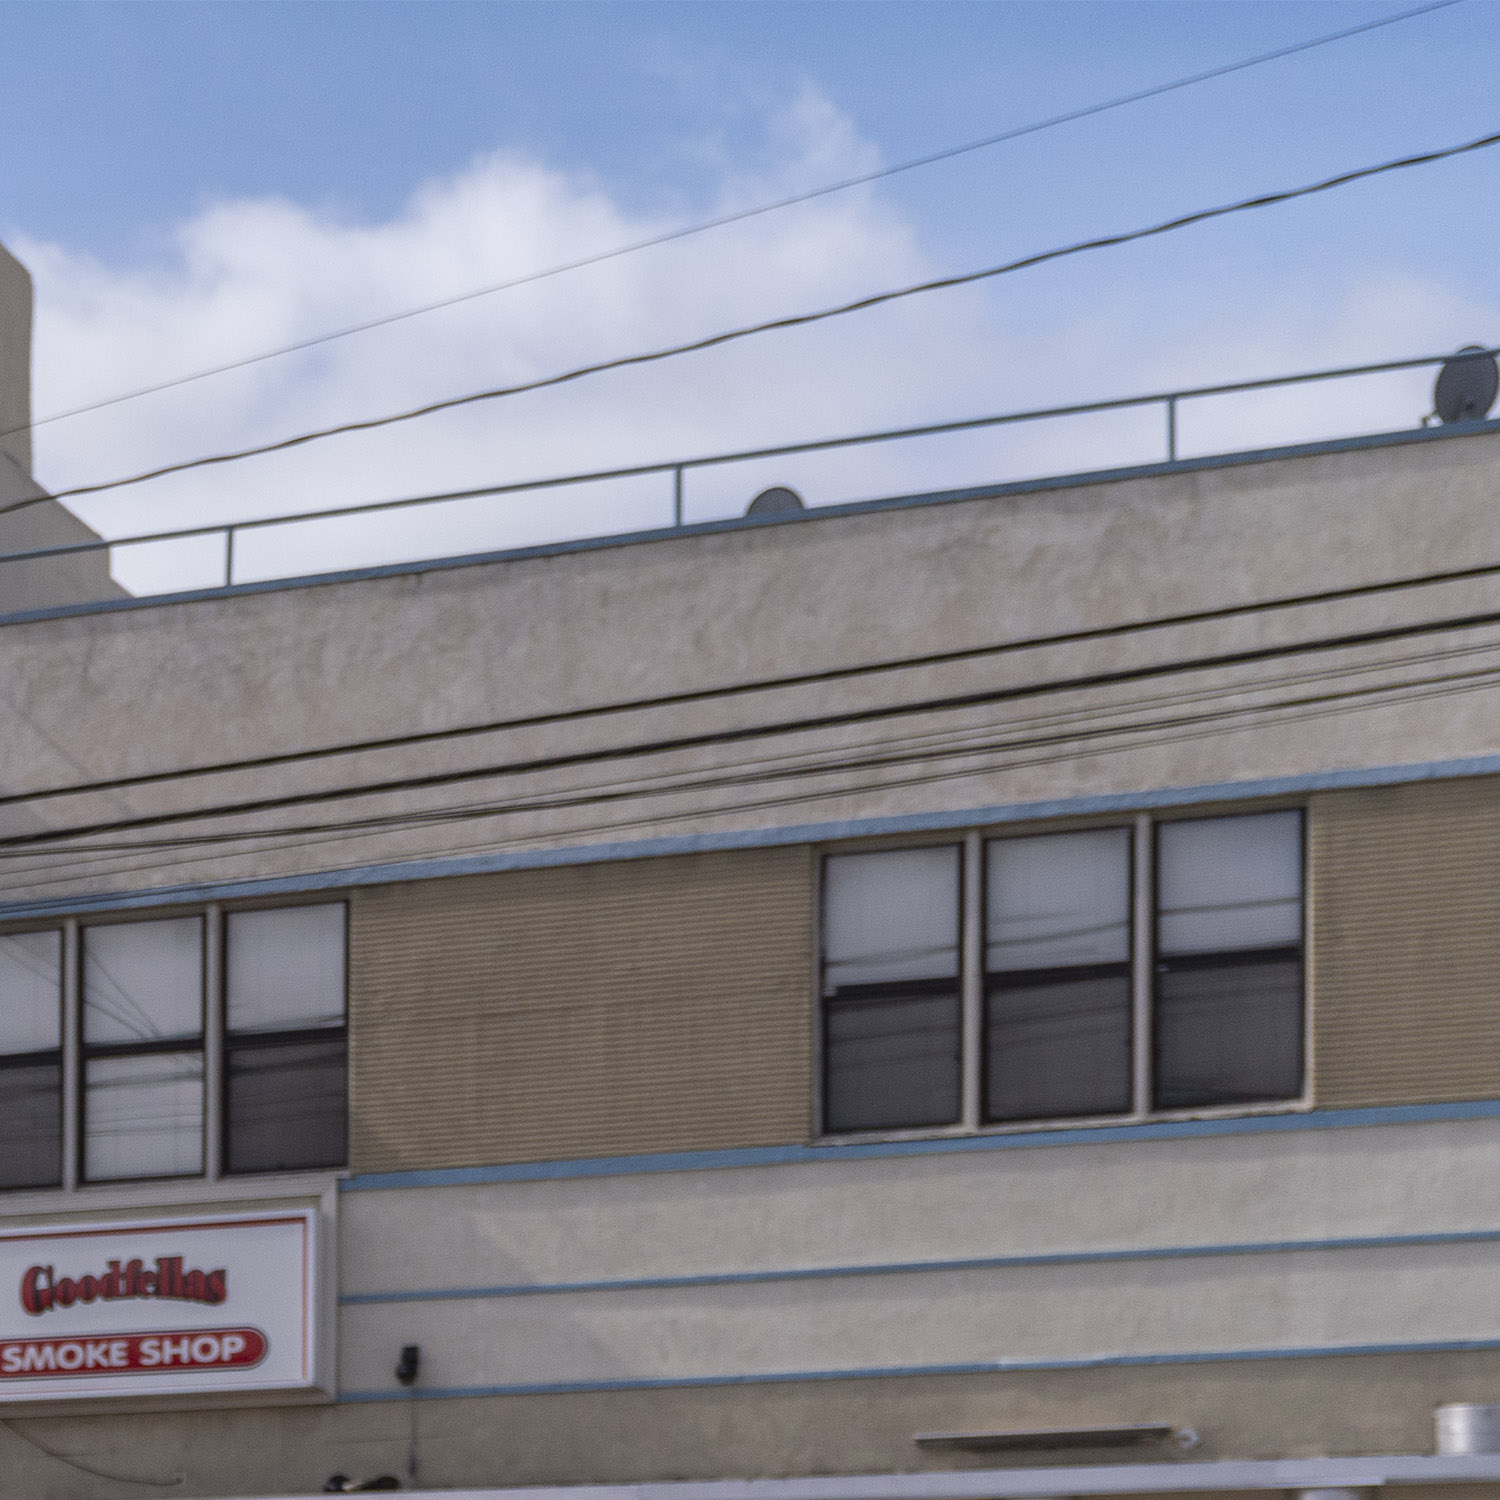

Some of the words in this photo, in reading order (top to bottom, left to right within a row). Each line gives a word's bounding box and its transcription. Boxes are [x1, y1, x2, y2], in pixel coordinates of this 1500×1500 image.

[20, 1256, 228, 1317] Goodfellas
[2, 1338, 129, 1373] SMOKE
[139, 1334, 246, 1367] SHOP
